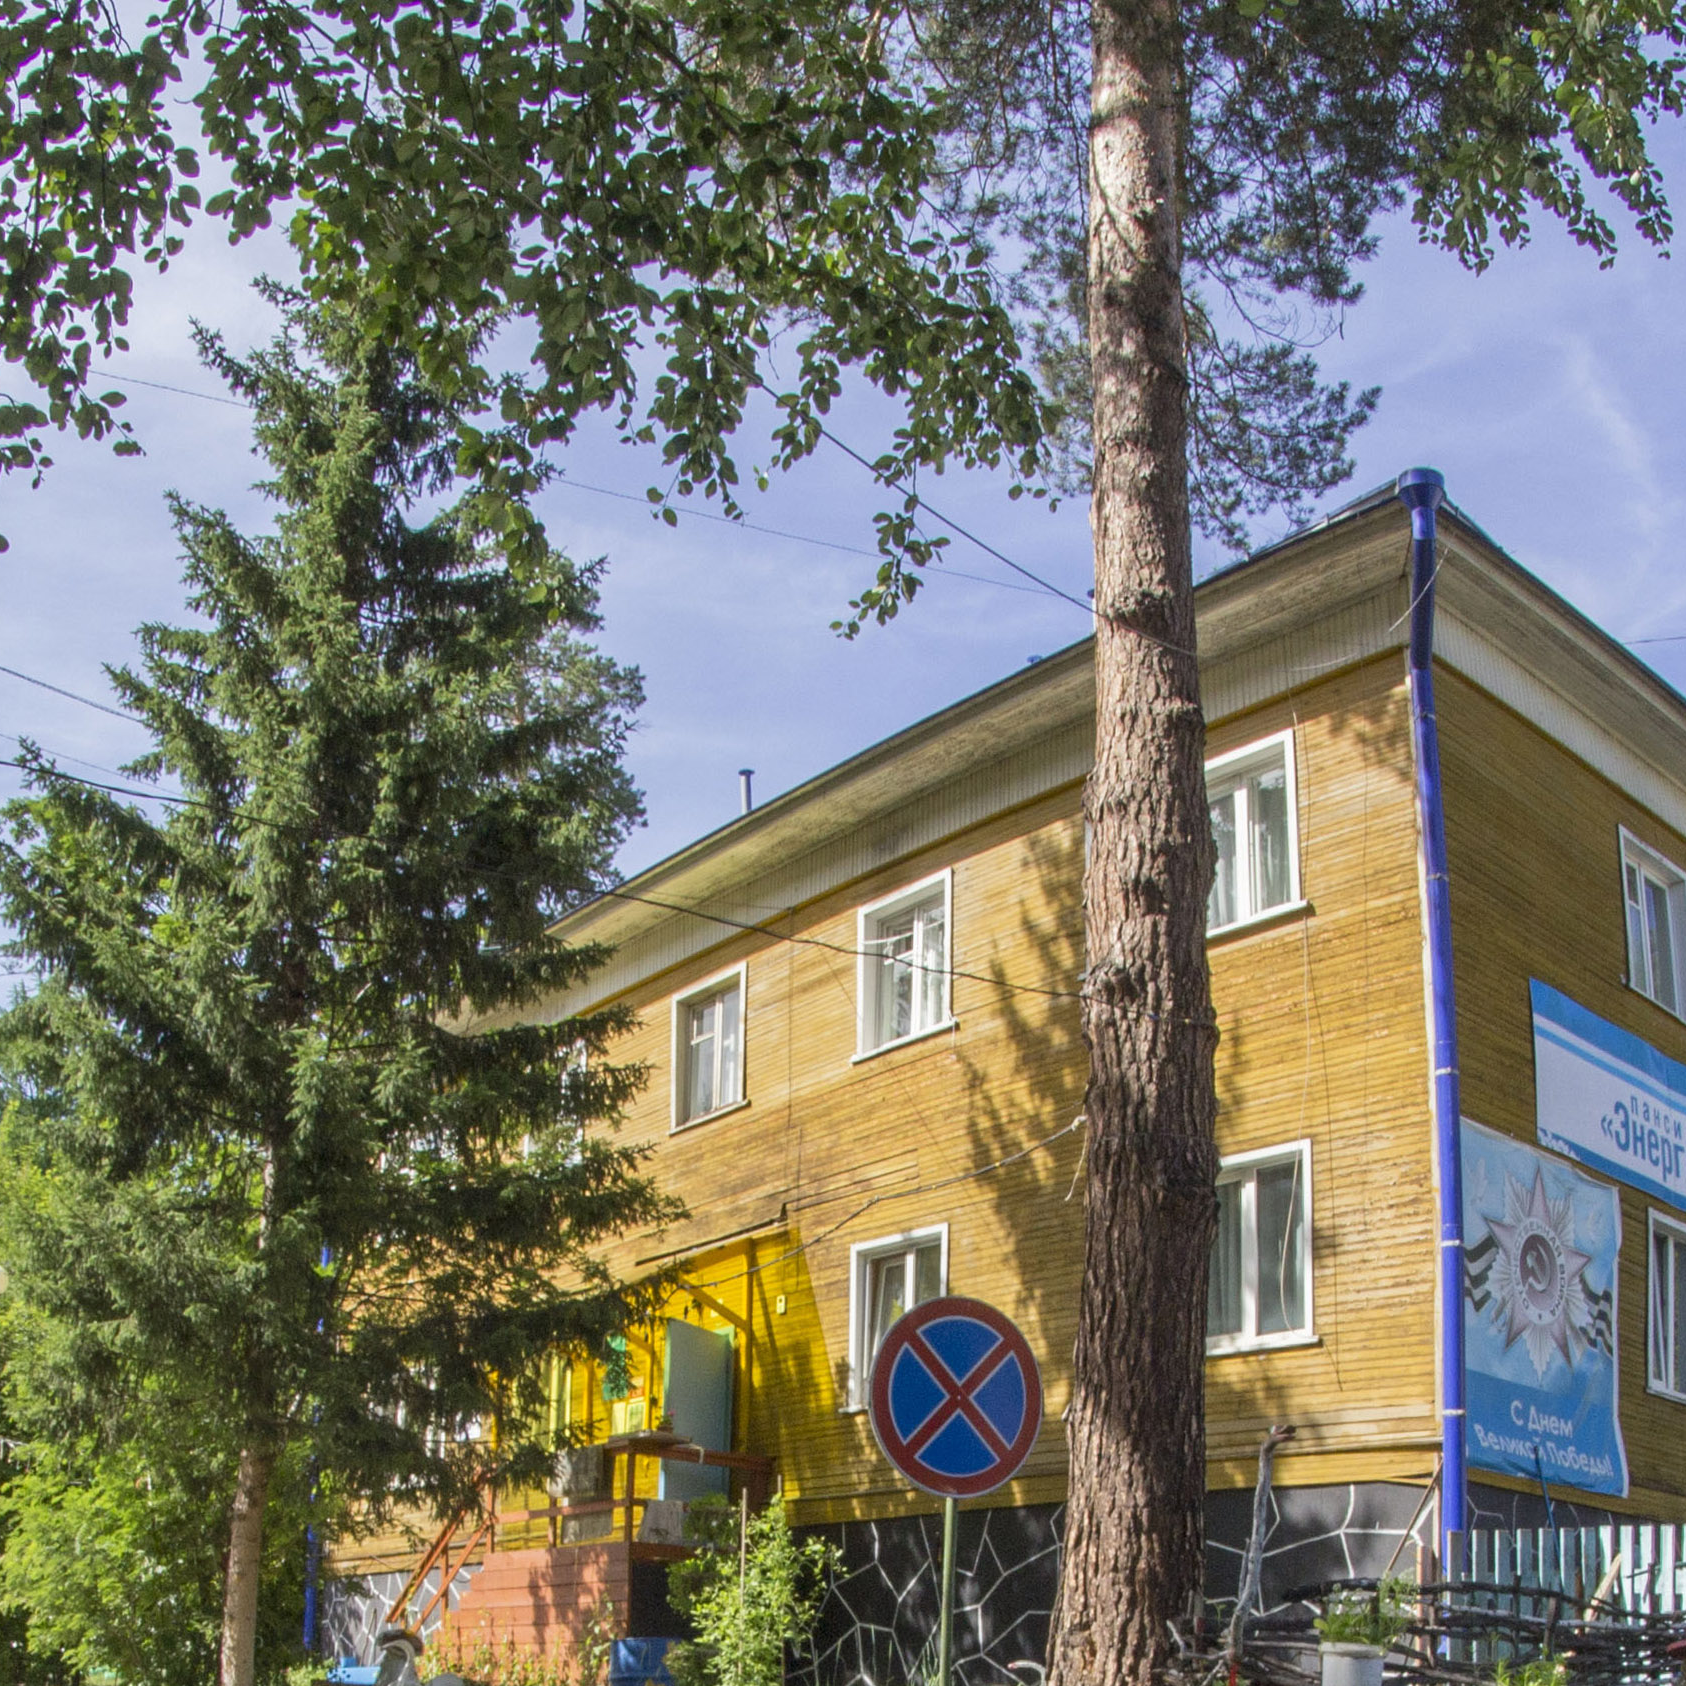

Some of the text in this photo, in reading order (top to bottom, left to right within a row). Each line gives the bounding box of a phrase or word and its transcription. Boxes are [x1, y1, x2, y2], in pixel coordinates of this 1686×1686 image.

[1510, 1400, 1574, 1439] С Днем
[1473, 1423, 1615, 1477] Великой Победы!
